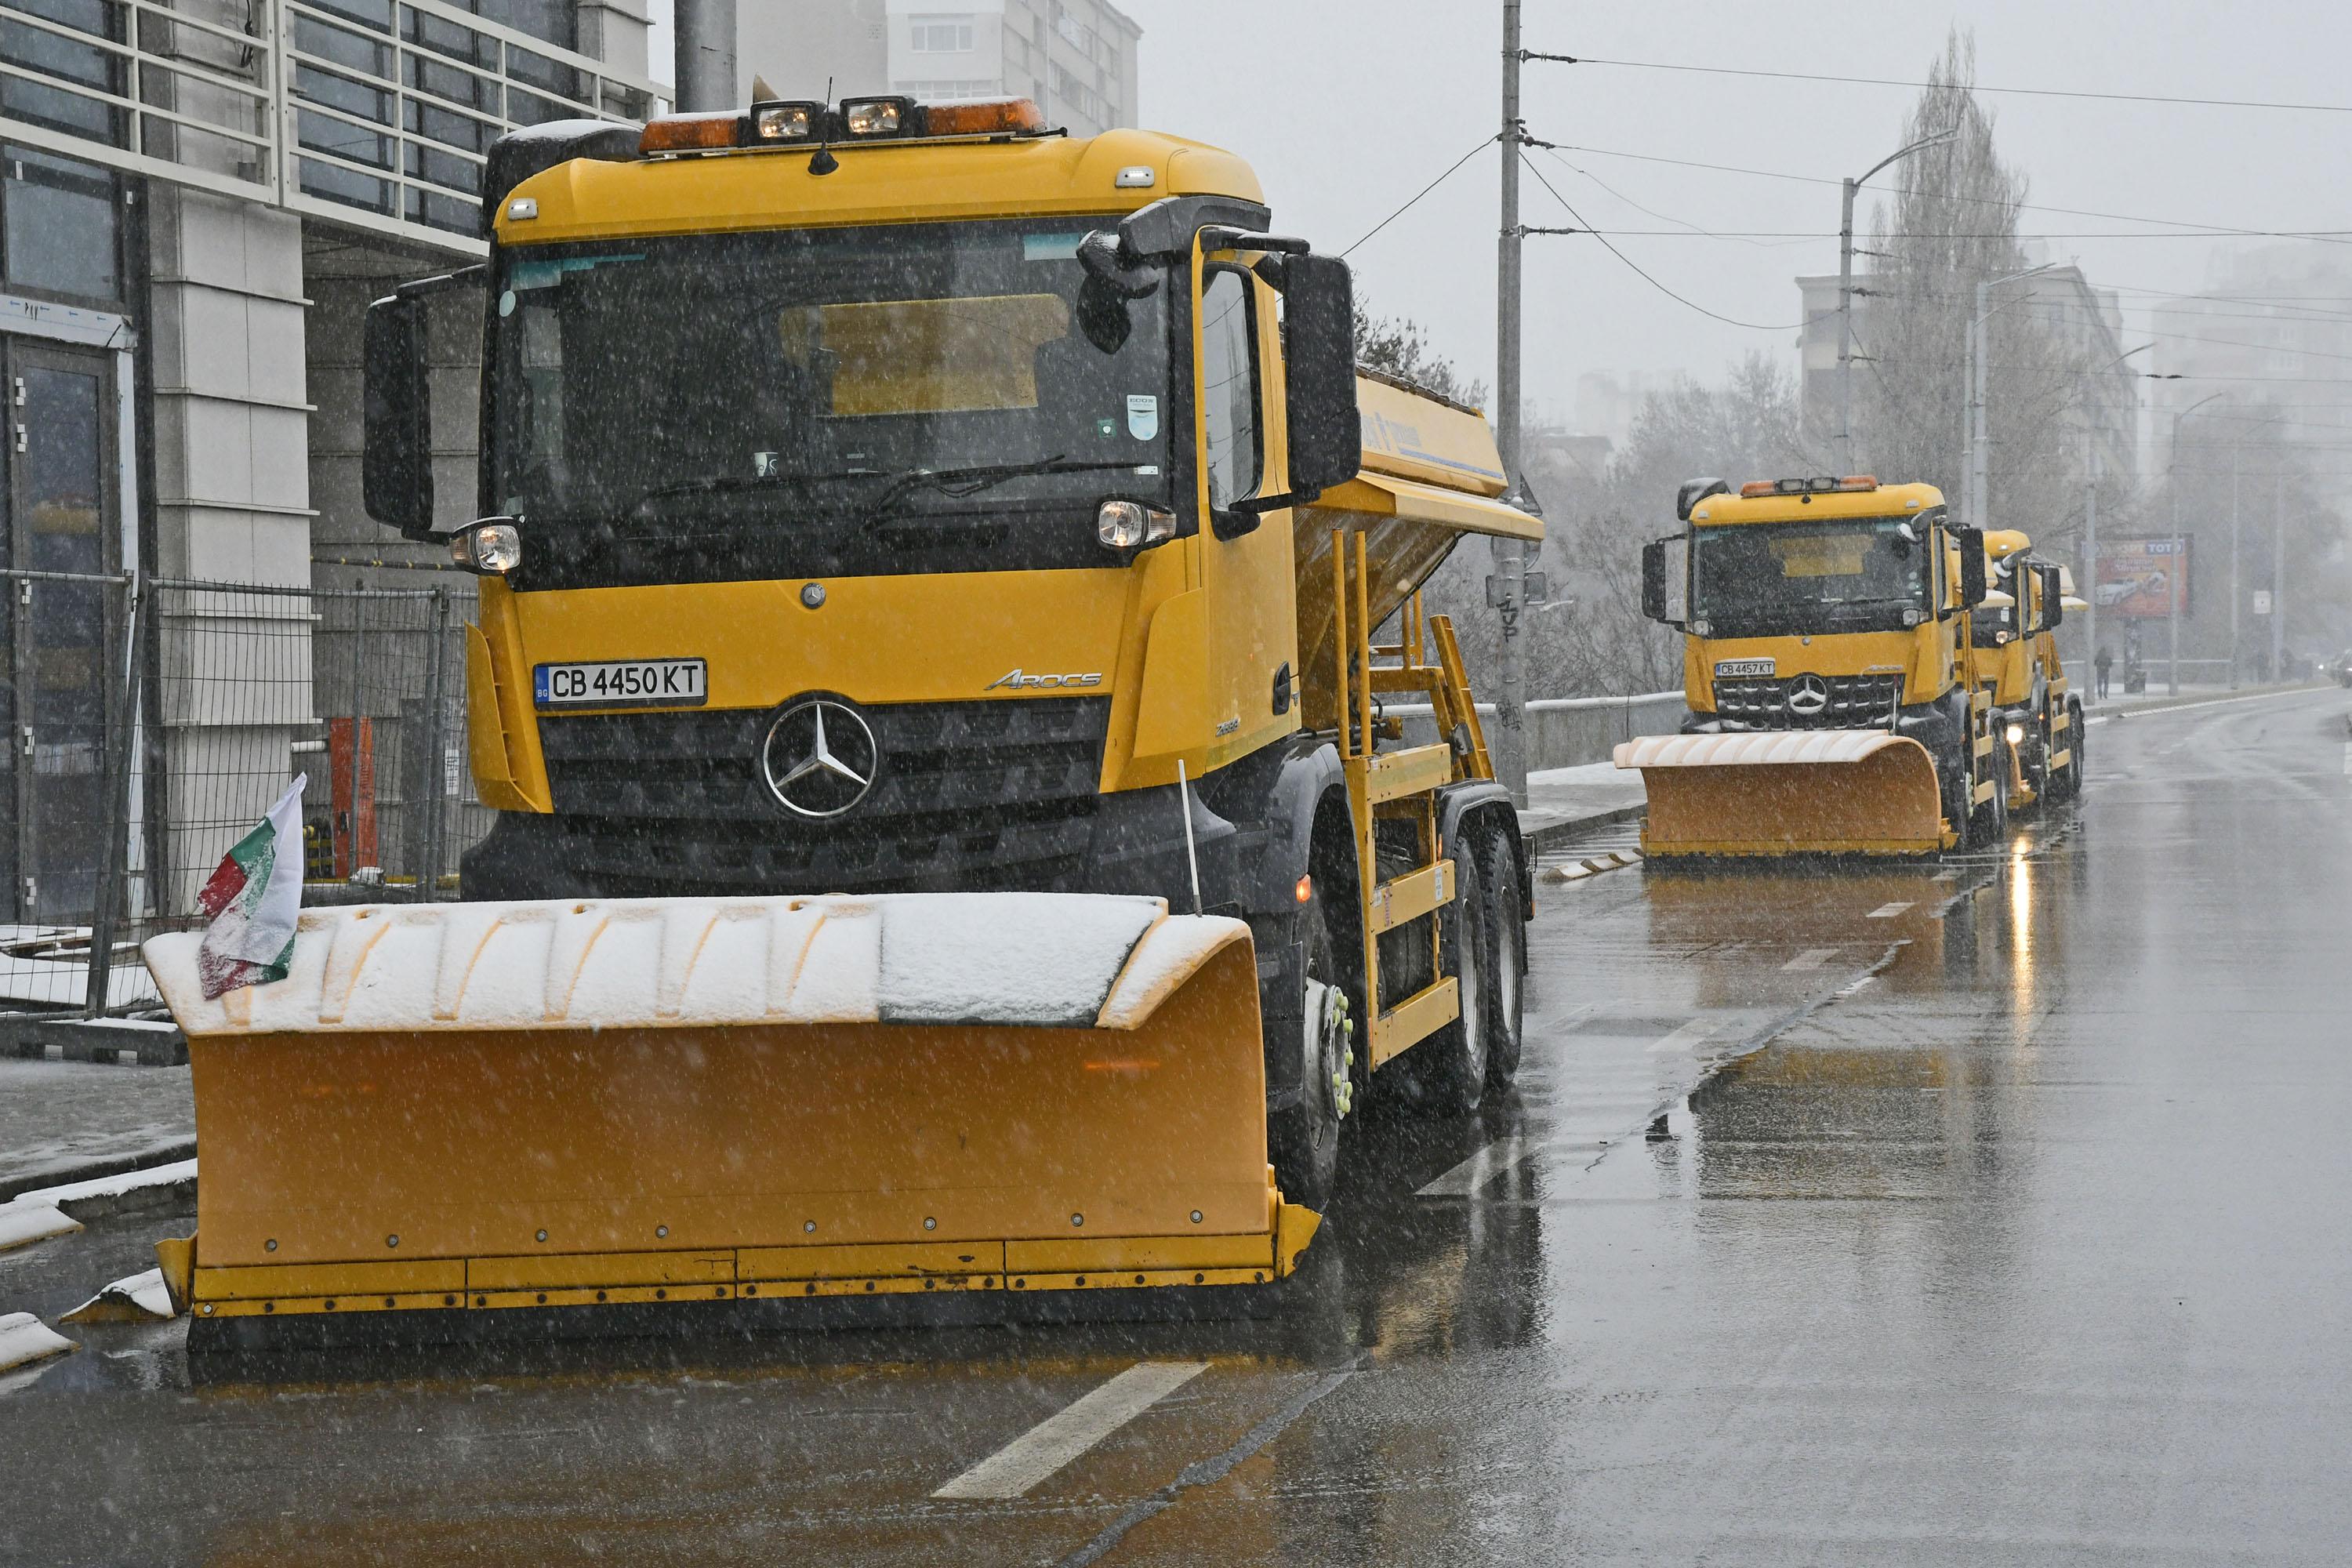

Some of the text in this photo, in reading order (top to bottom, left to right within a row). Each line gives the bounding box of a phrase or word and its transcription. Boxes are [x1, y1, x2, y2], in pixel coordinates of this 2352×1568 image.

[1722, 665, 1733, 674] CB
[1735, 664, 1758, 673] 4457
[1759, 663, 1772, 673] KT
[553, 665, 699, 697] CB 4450 KT
[983, 668, 1102, 691] AROCS
[537, 689, 548, 698] BG
